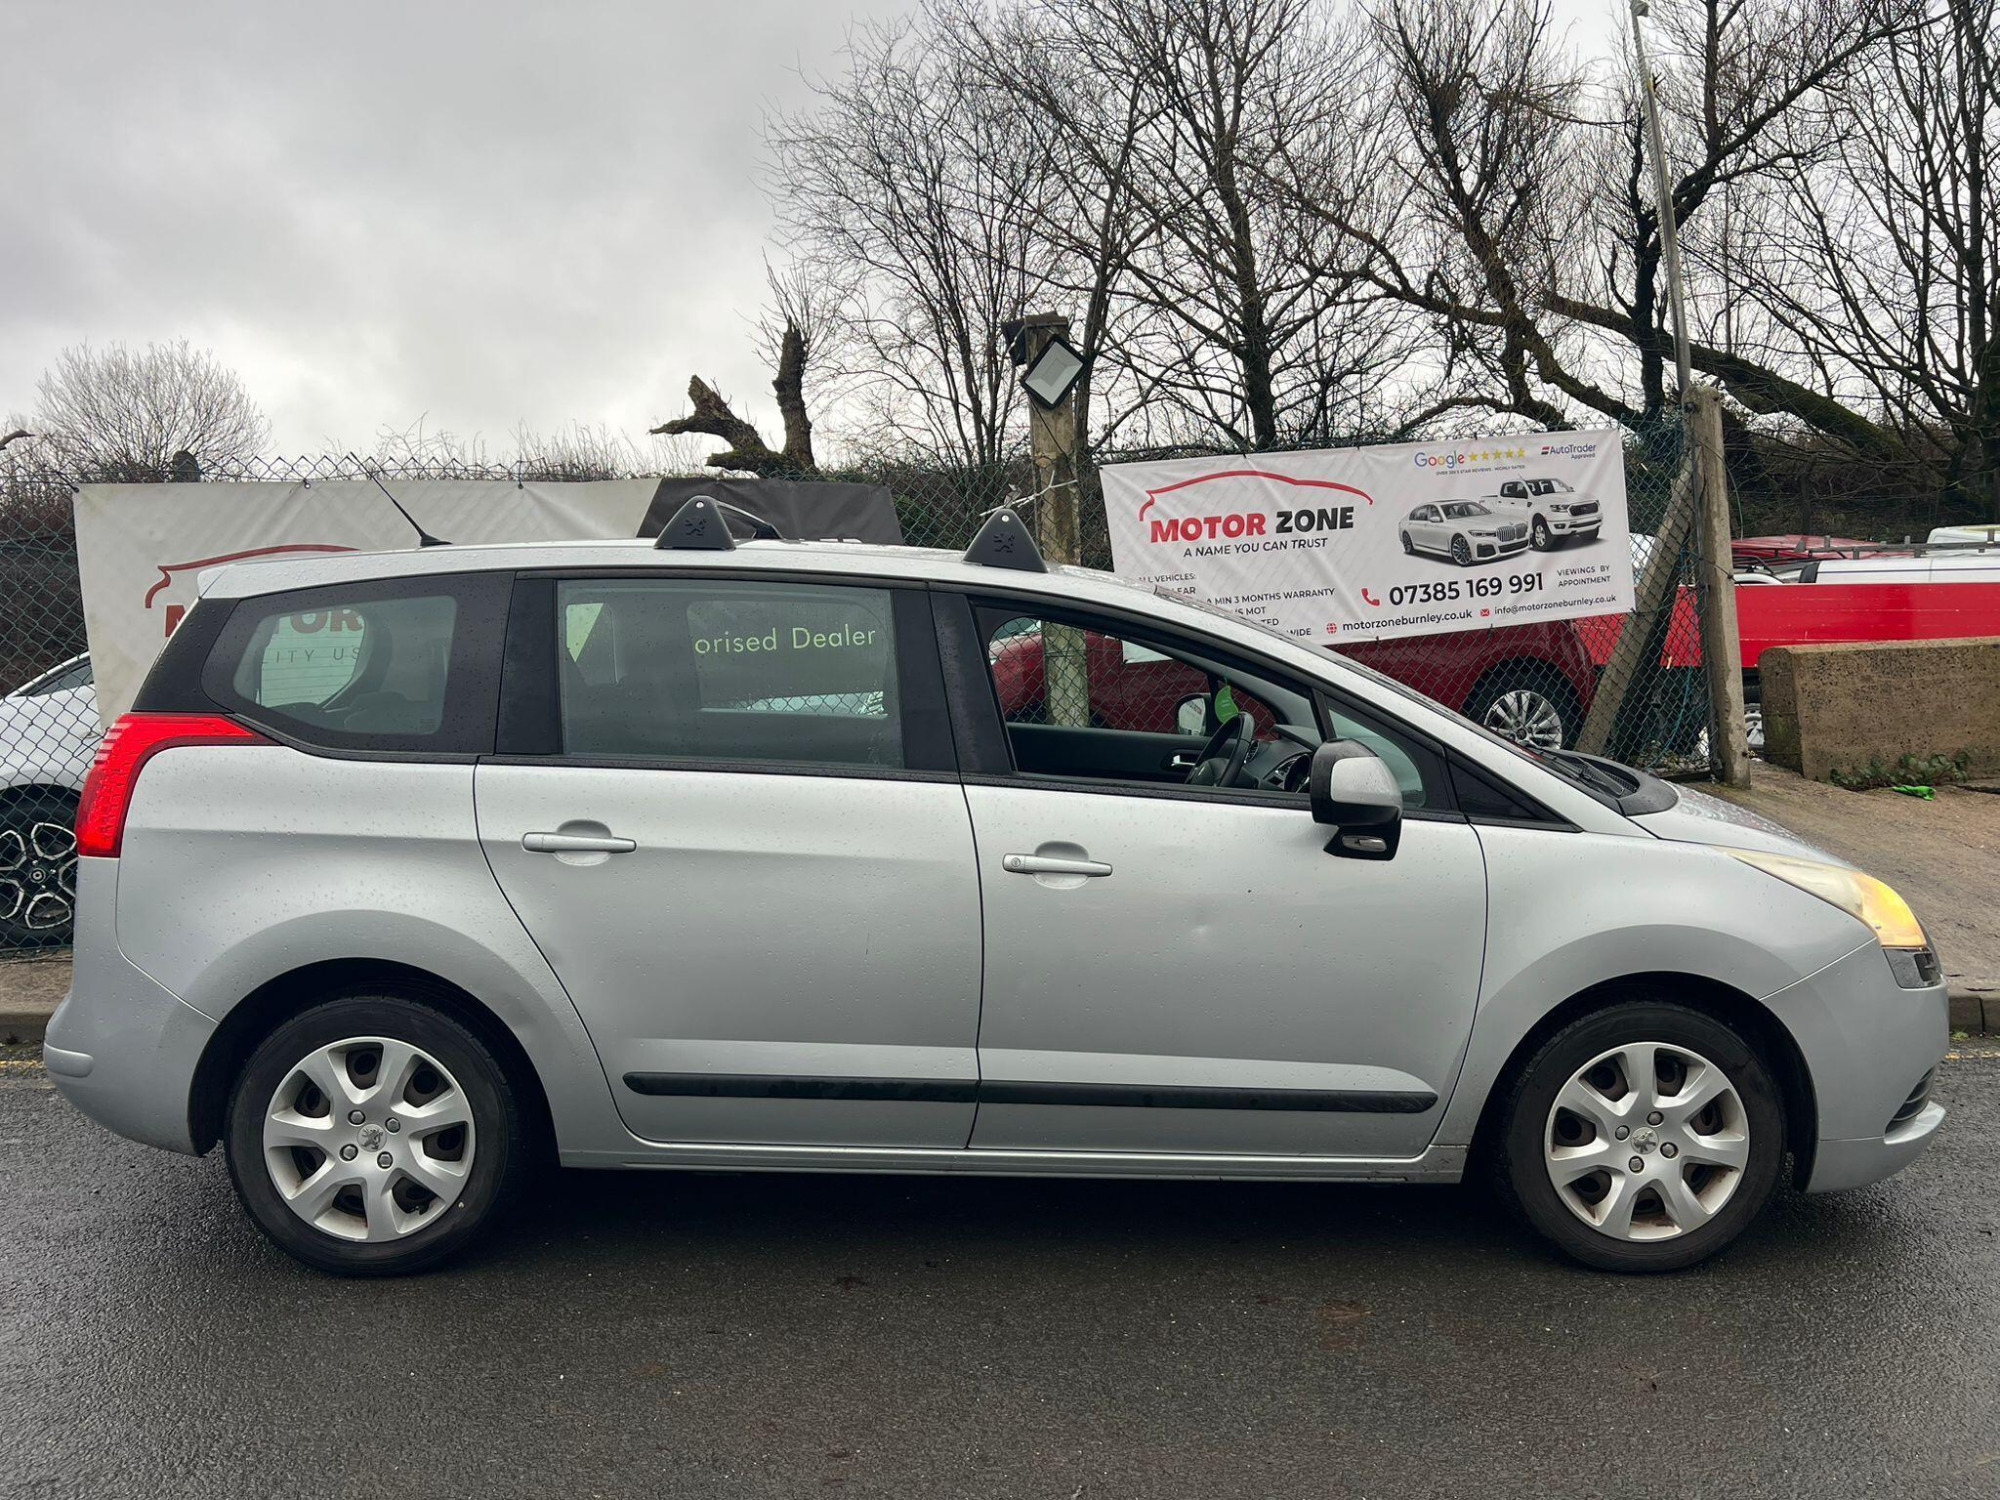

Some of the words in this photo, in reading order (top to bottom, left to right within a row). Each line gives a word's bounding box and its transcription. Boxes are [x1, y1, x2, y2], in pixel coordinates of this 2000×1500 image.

[1550, 443, 1596, 455] AutoTrader
[1414, 450, 1465, 469] Google
[1150, 512, 1266, 543] MOTOR
[1275, 506, 1354, 534] ZONE
[1183, 547, 1192, 558] A
[1195, 544, 1231, 557] NAME
[1234, 542, 1260, 554] YOU
[1262, 540, 1288, 552] CAN
[1291, 537, 1328, 550] TRUST
[1556, 566, 1596, 577] VIEWINGS
[1600, 565, 1610, 573] BY
[1388, 581, 1460, 606] 07385
[1465, 577, 1501, 598] 169
[1509, 572, 1543, 594] 991
[1558, 576, 1611, 588] APPOINTMENT
[1214, 596, 1232, 605] MIN
[1234, 596, 1239, 604] 3
[1241, 592, 1281, 603] MONTHS
[1283, 588, 1335, 599] WARRANTY
[1494, 594, 1617, 616] info@motorzoneburnley.co.uk
[1246, 606, 1266, 615] MOT
[1342, 609, 1473, 632] motorzoneburnley.co.uk
[792, 623, 876, 649] Dealer
